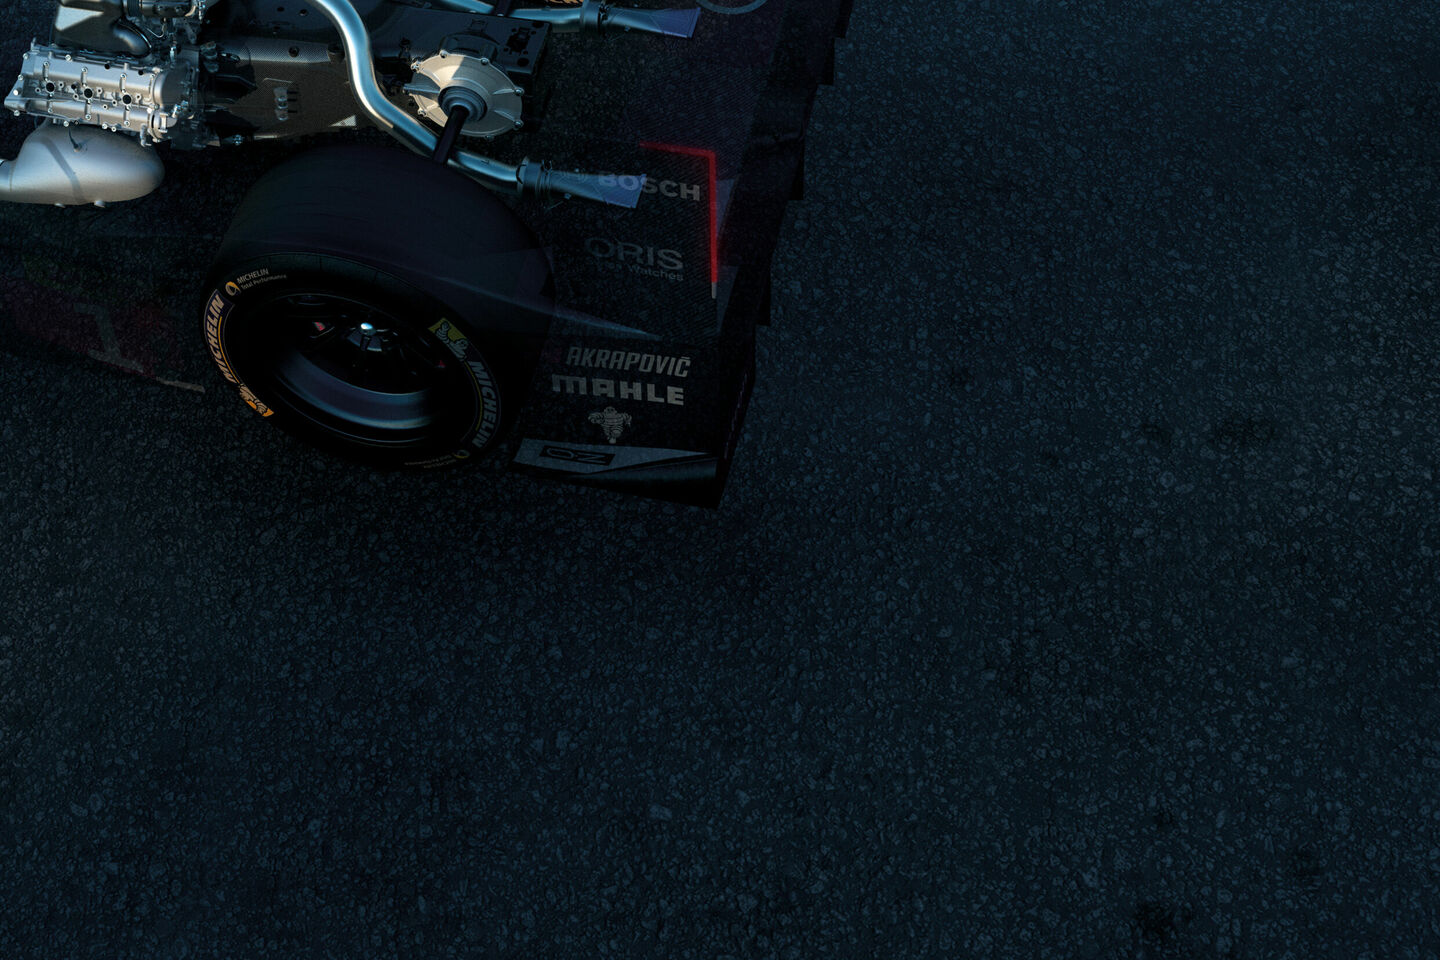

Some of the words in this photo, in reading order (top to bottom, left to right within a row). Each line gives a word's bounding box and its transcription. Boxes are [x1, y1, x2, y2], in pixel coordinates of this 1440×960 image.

[598, 173, 701, 202] BOSCH
[584, 236, 685, 271] ORIS
[566, 345, 692, 378] AKRAPOVIČ
[467, 360, 498, 449] MICHELIN
[551, 373, 685, 407] MAHLE
